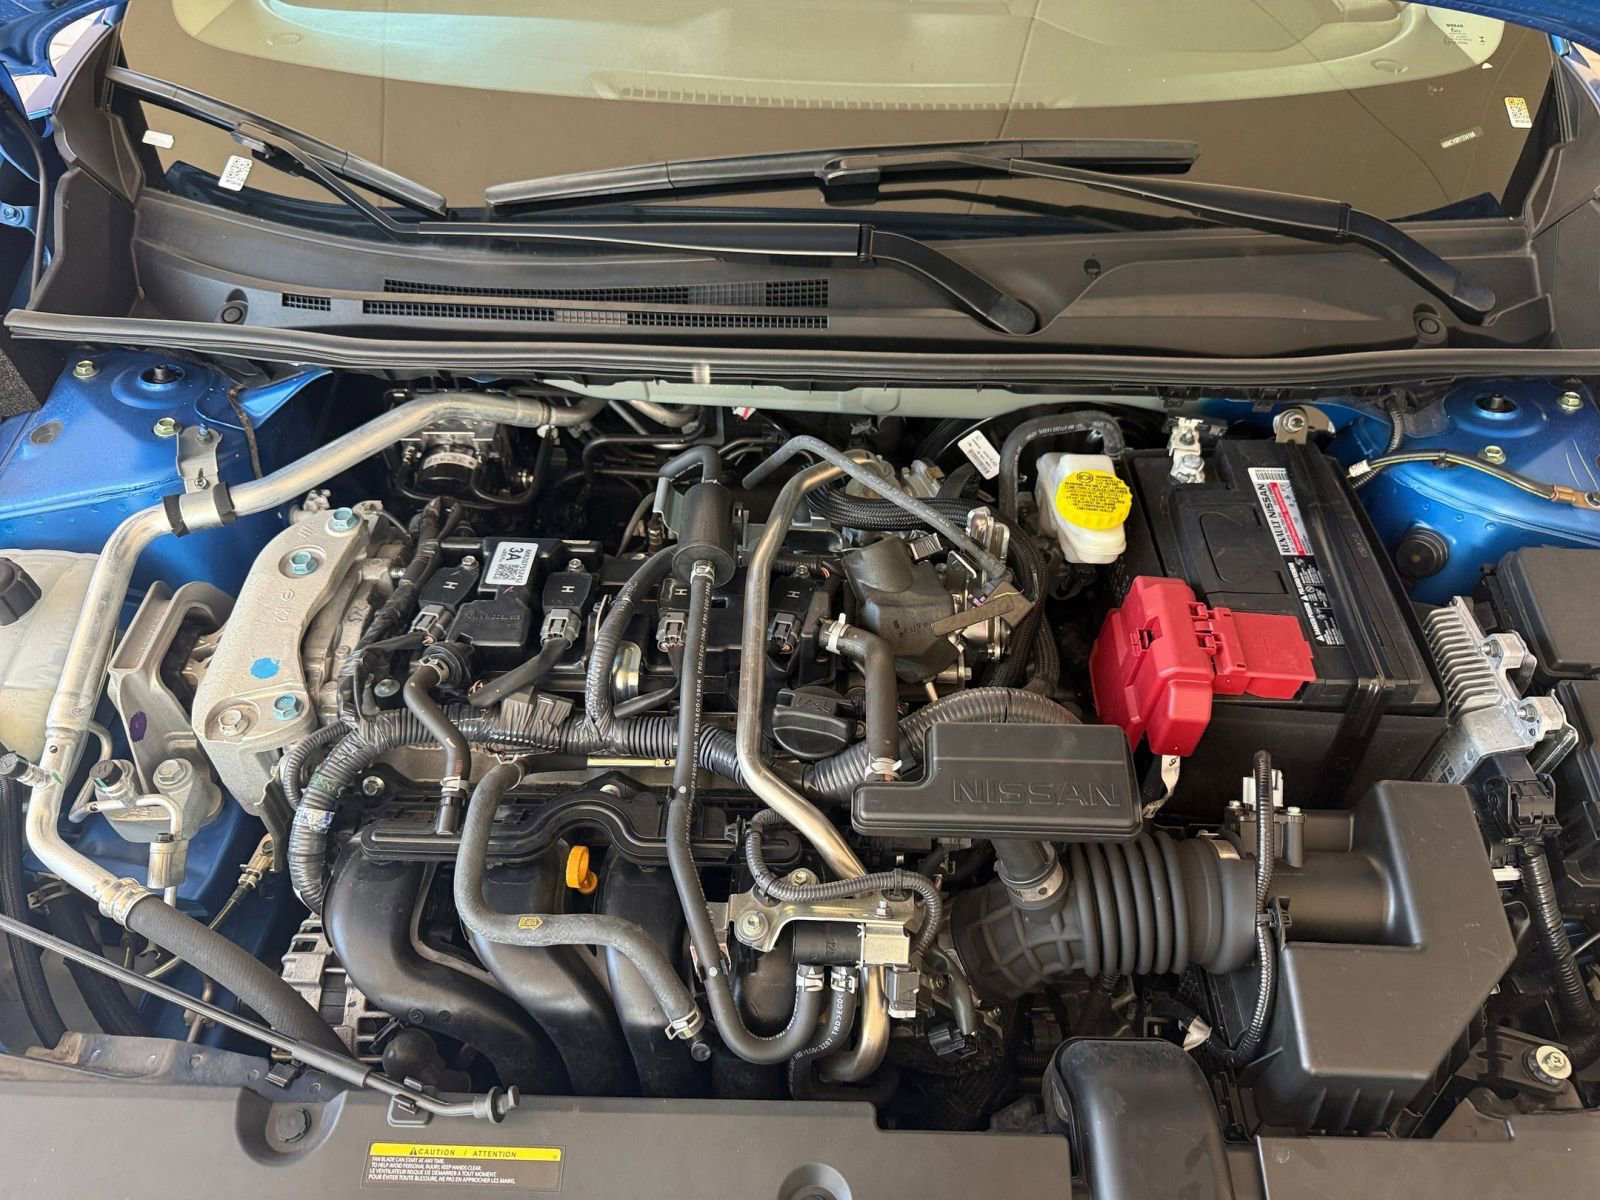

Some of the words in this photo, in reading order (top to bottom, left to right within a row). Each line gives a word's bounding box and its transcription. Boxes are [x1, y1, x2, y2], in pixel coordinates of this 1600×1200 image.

[1257, 483, 1278, 518] NISSAN
[1270, 520, 1292, 553] RENAULT
[506, 547, 524, 561] 3A
[952, 778, 1121, 807] NISSAN
[418, 1148, 456, 1156] CAUTION
[472, 1150, 517, 1158] ATTENTION
